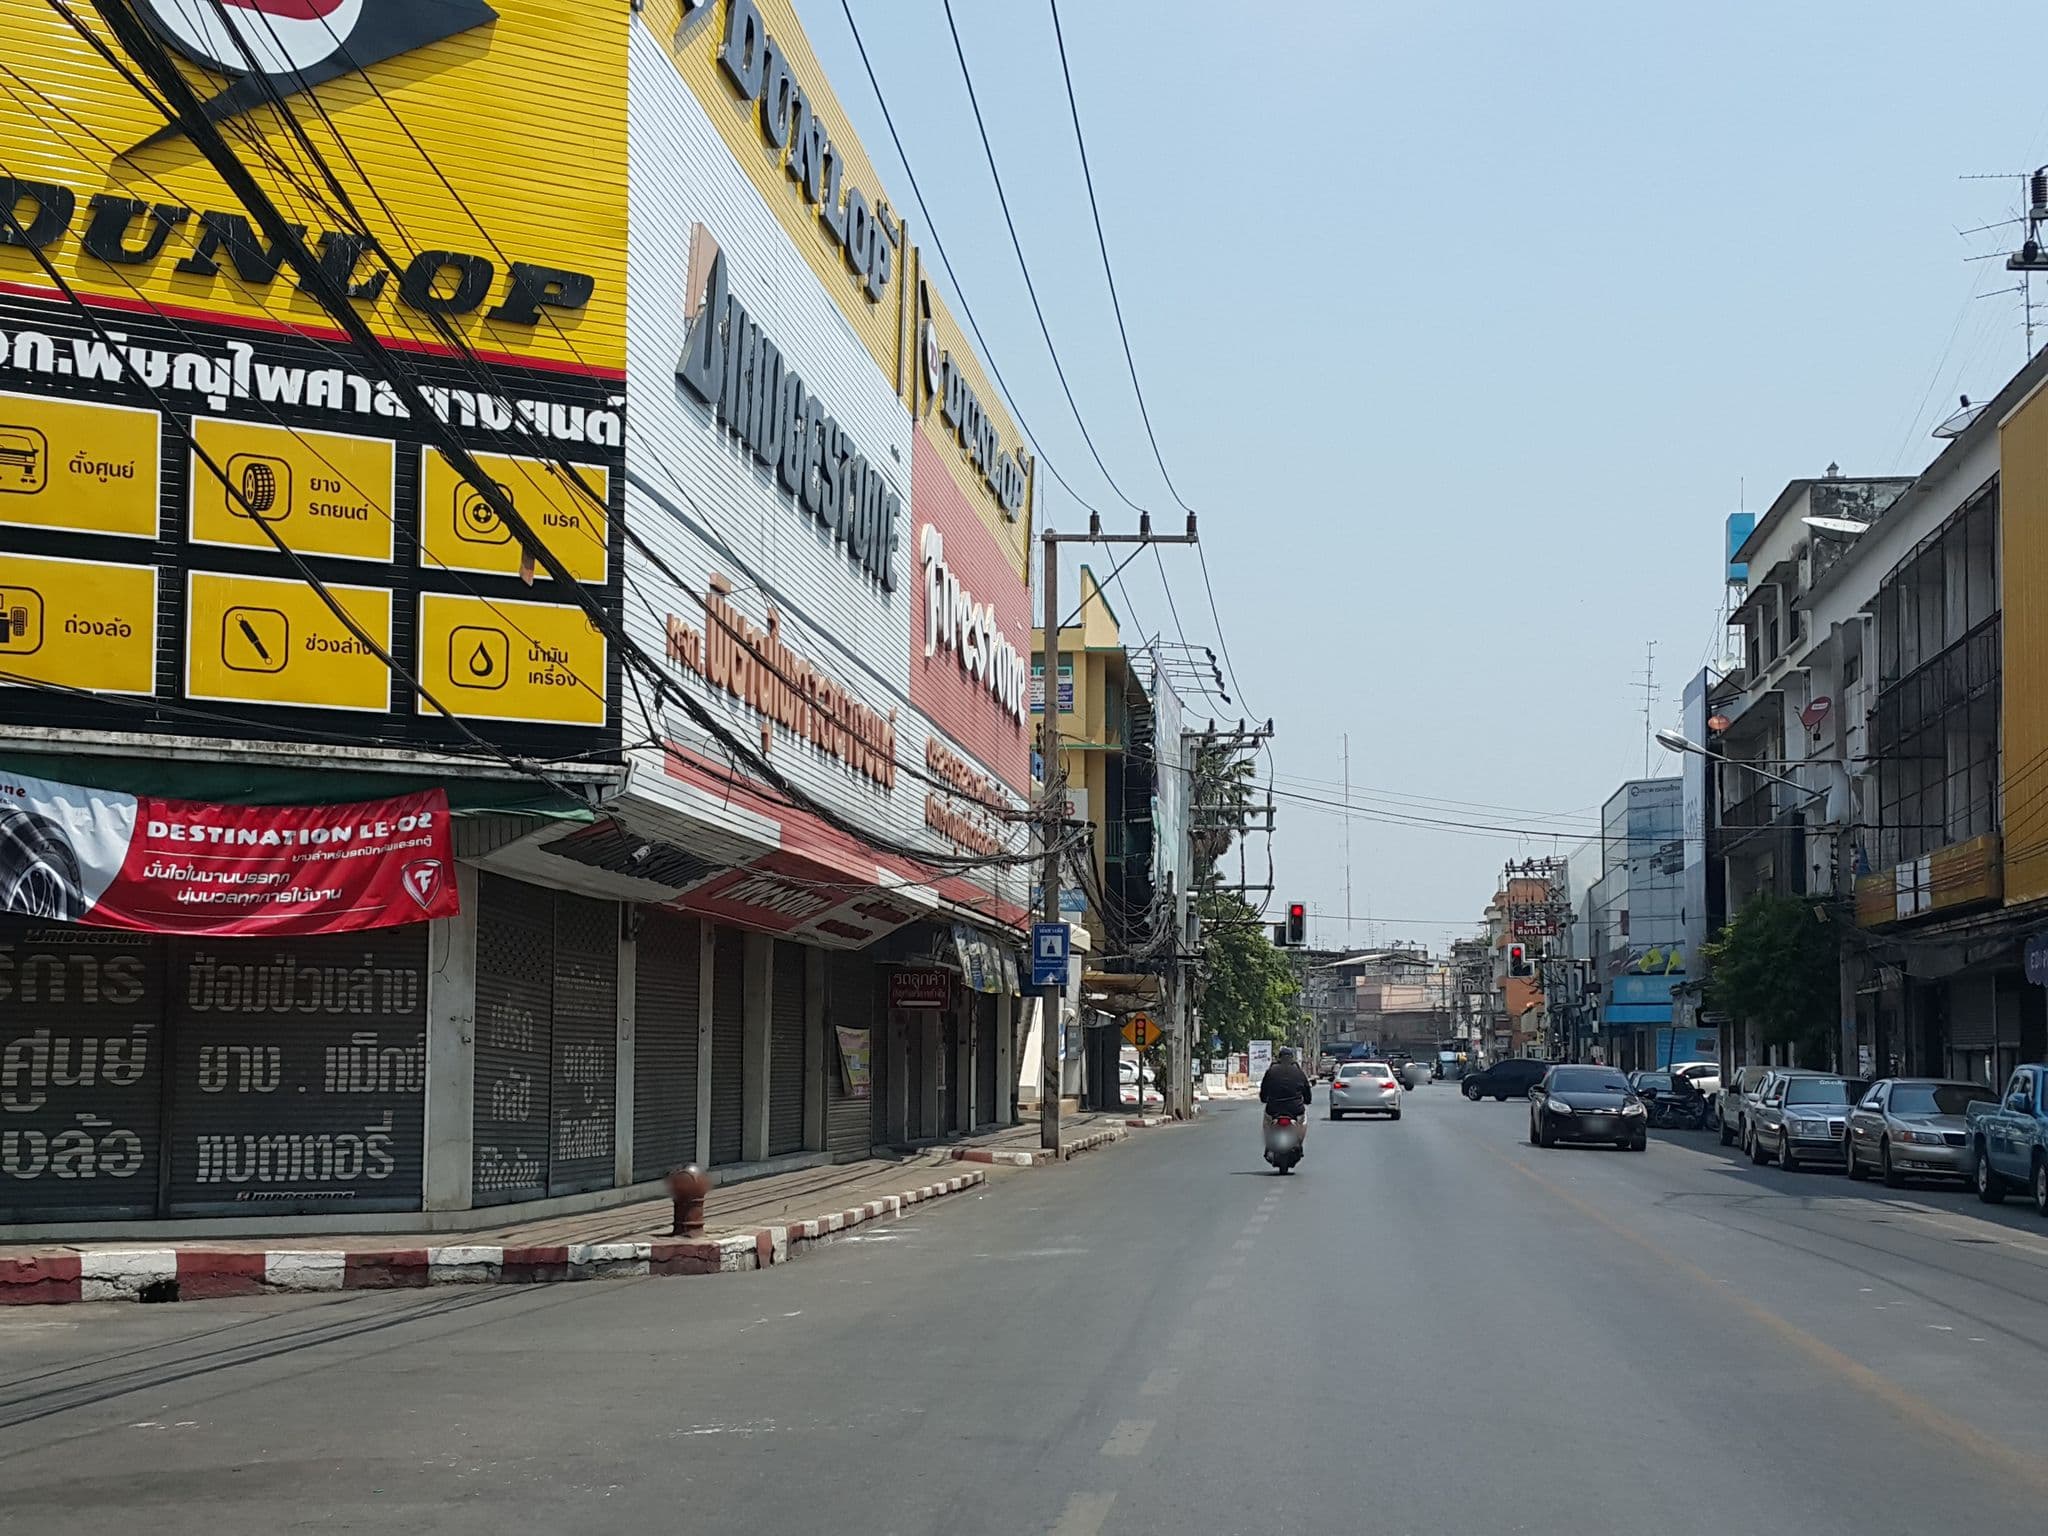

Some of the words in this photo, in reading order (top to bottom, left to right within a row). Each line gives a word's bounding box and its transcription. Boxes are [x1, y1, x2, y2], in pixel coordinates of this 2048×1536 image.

[717, 0, 891, 303] DUNLOP
[0, 176, 595, 326] DUNLOP
[675, 222, 900, 593] BRIDGESTONE
[940, 350, 1024, 523] DUNLOP
[69, 451, 135, 484] ตั้งศูนย์
[310, 477, 341, 497] ยาง
[309, 500, 369, 523] รถยนต์
[543, 511, 580, 531] เบรค
[65, 617, 132, 640] ถ่วงล้อ
[920, 523, 1026, 728] Firestone
[305, 632, 375, 658] ช่วงล่าง
[528, 641, 569, 665] น้ำมัน
[528, 667, 578, 689] เครื่อง
[147, 821, 352, 846] DESTINATION
[199, 1046, 281, 1093] ยาง
[196, 1109, 395, 1183] แบตเตอรี่
